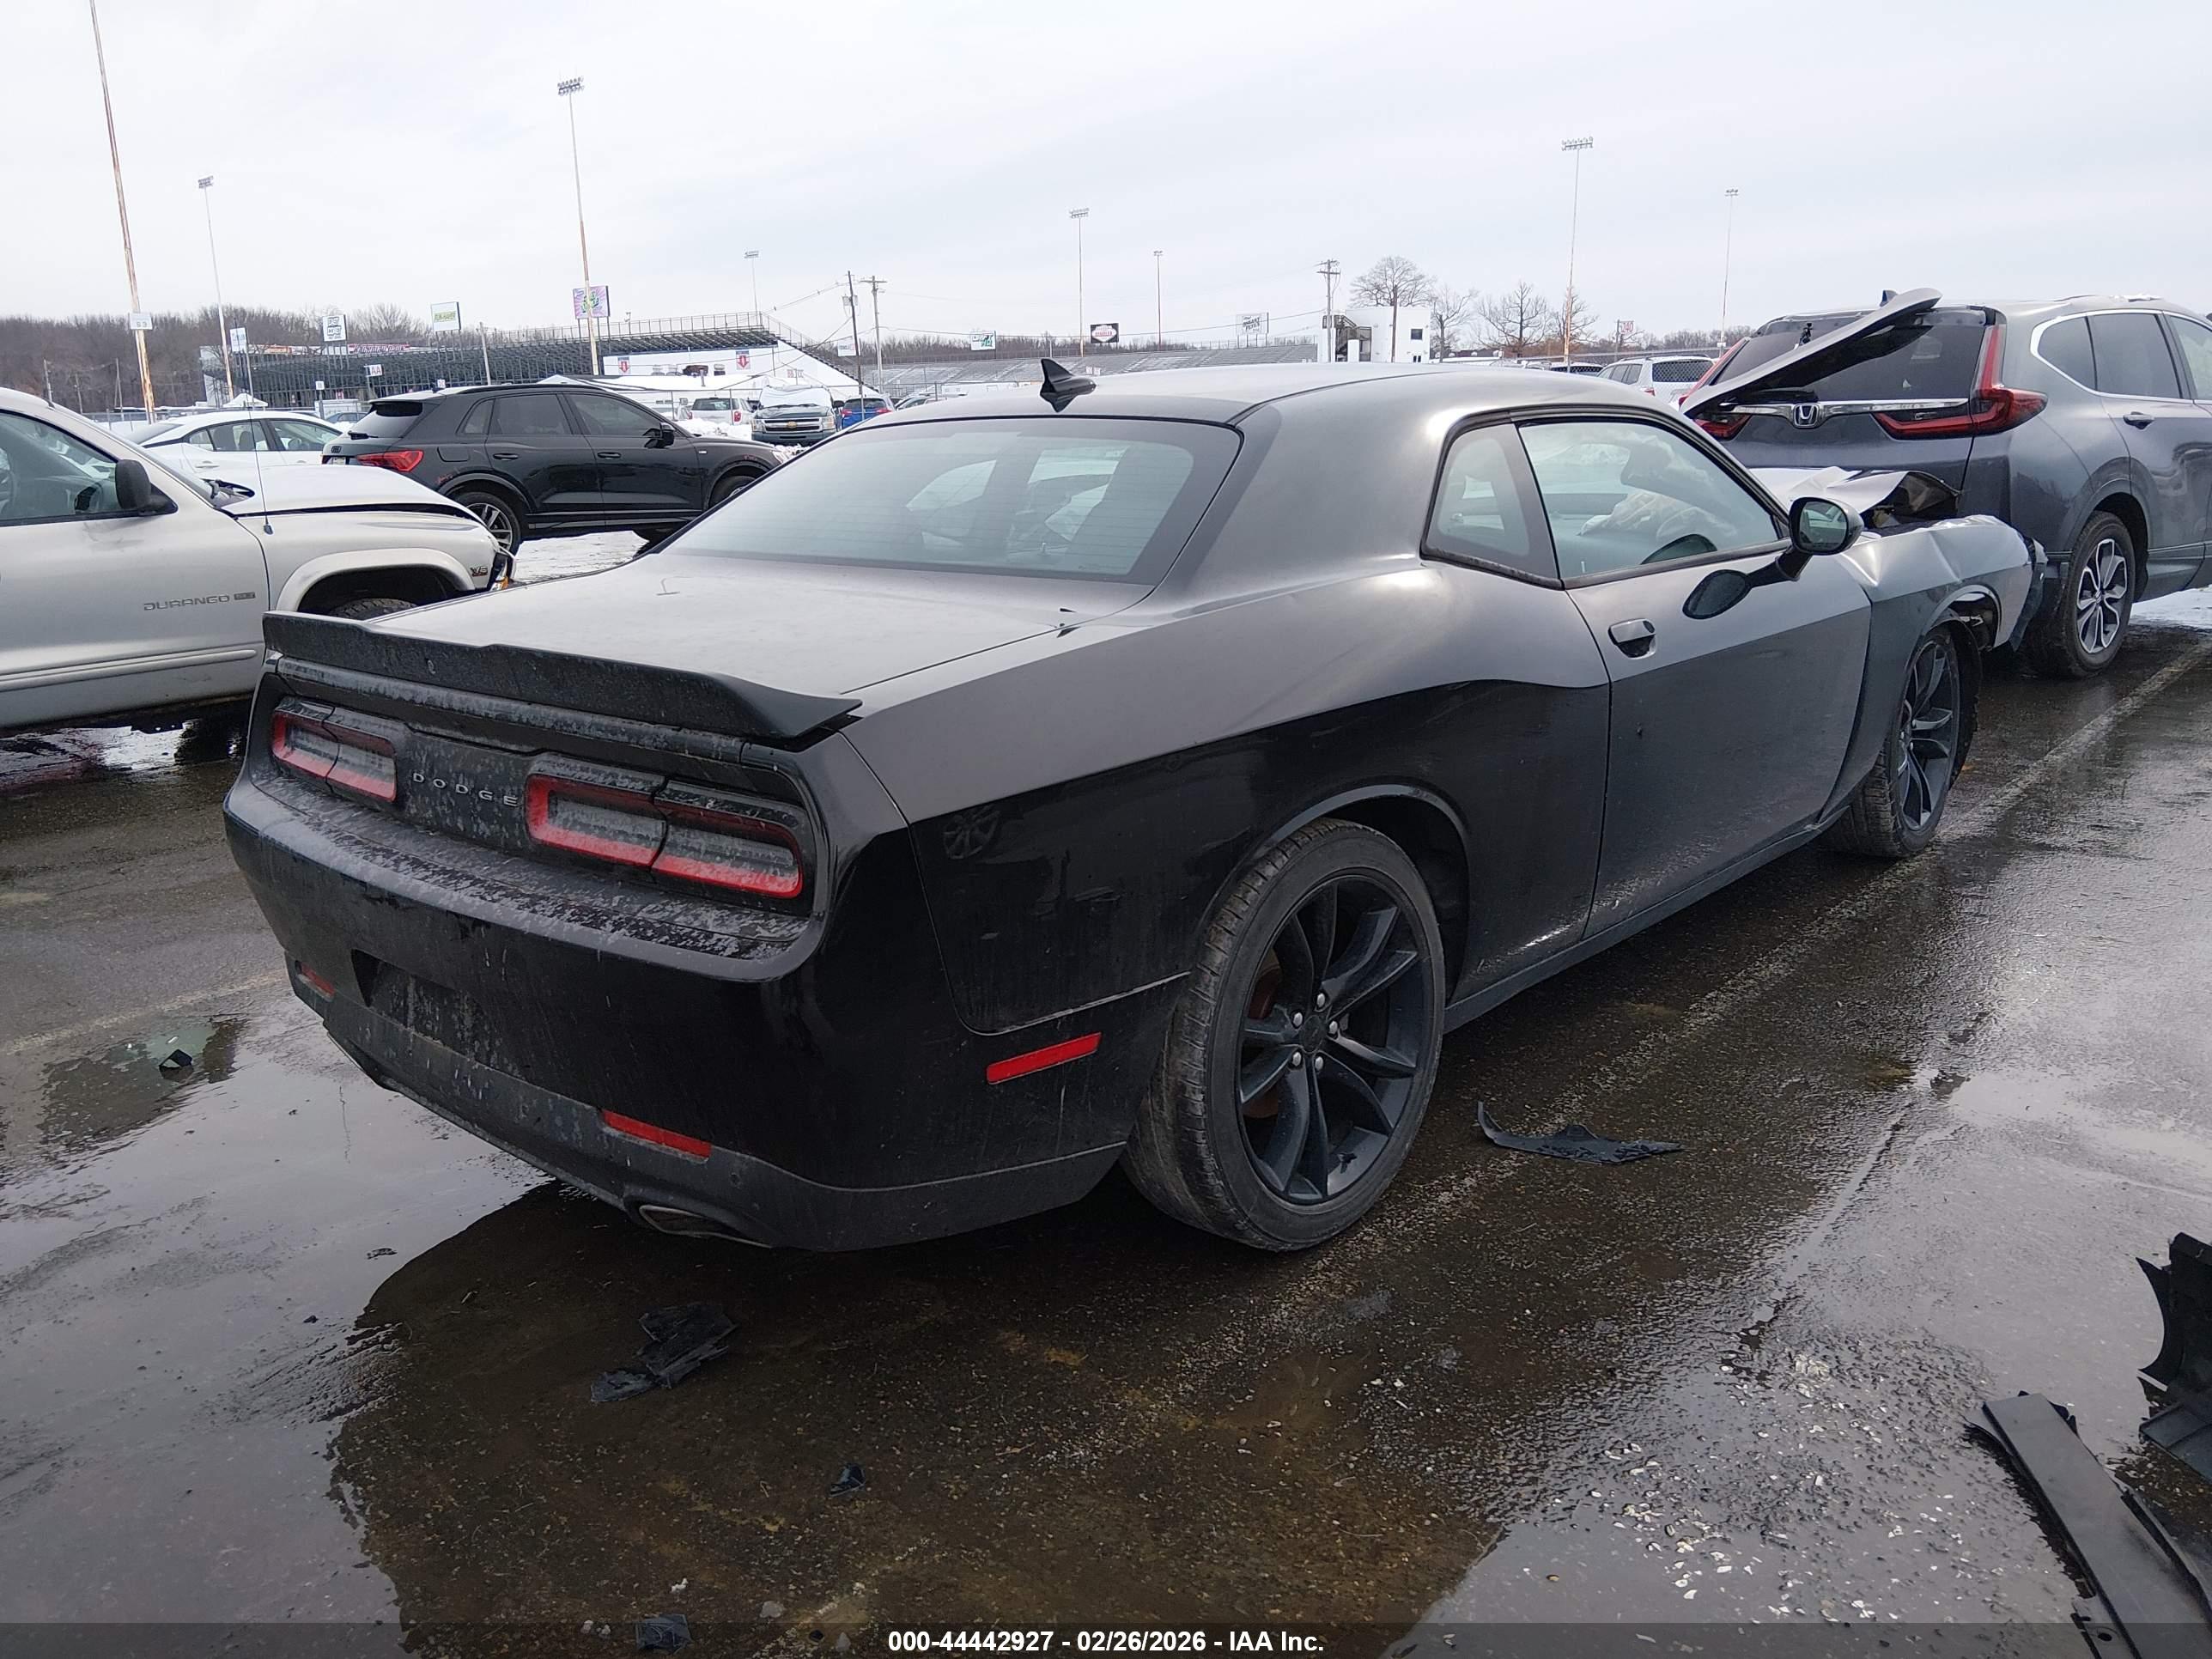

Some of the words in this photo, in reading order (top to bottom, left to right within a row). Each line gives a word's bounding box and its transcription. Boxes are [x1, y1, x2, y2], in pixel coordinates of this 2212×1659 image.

[371, 365, 382, 375] AA
[143, 595, 230, 611] DURANGO
[412, 772, 519, 806] DODGE
